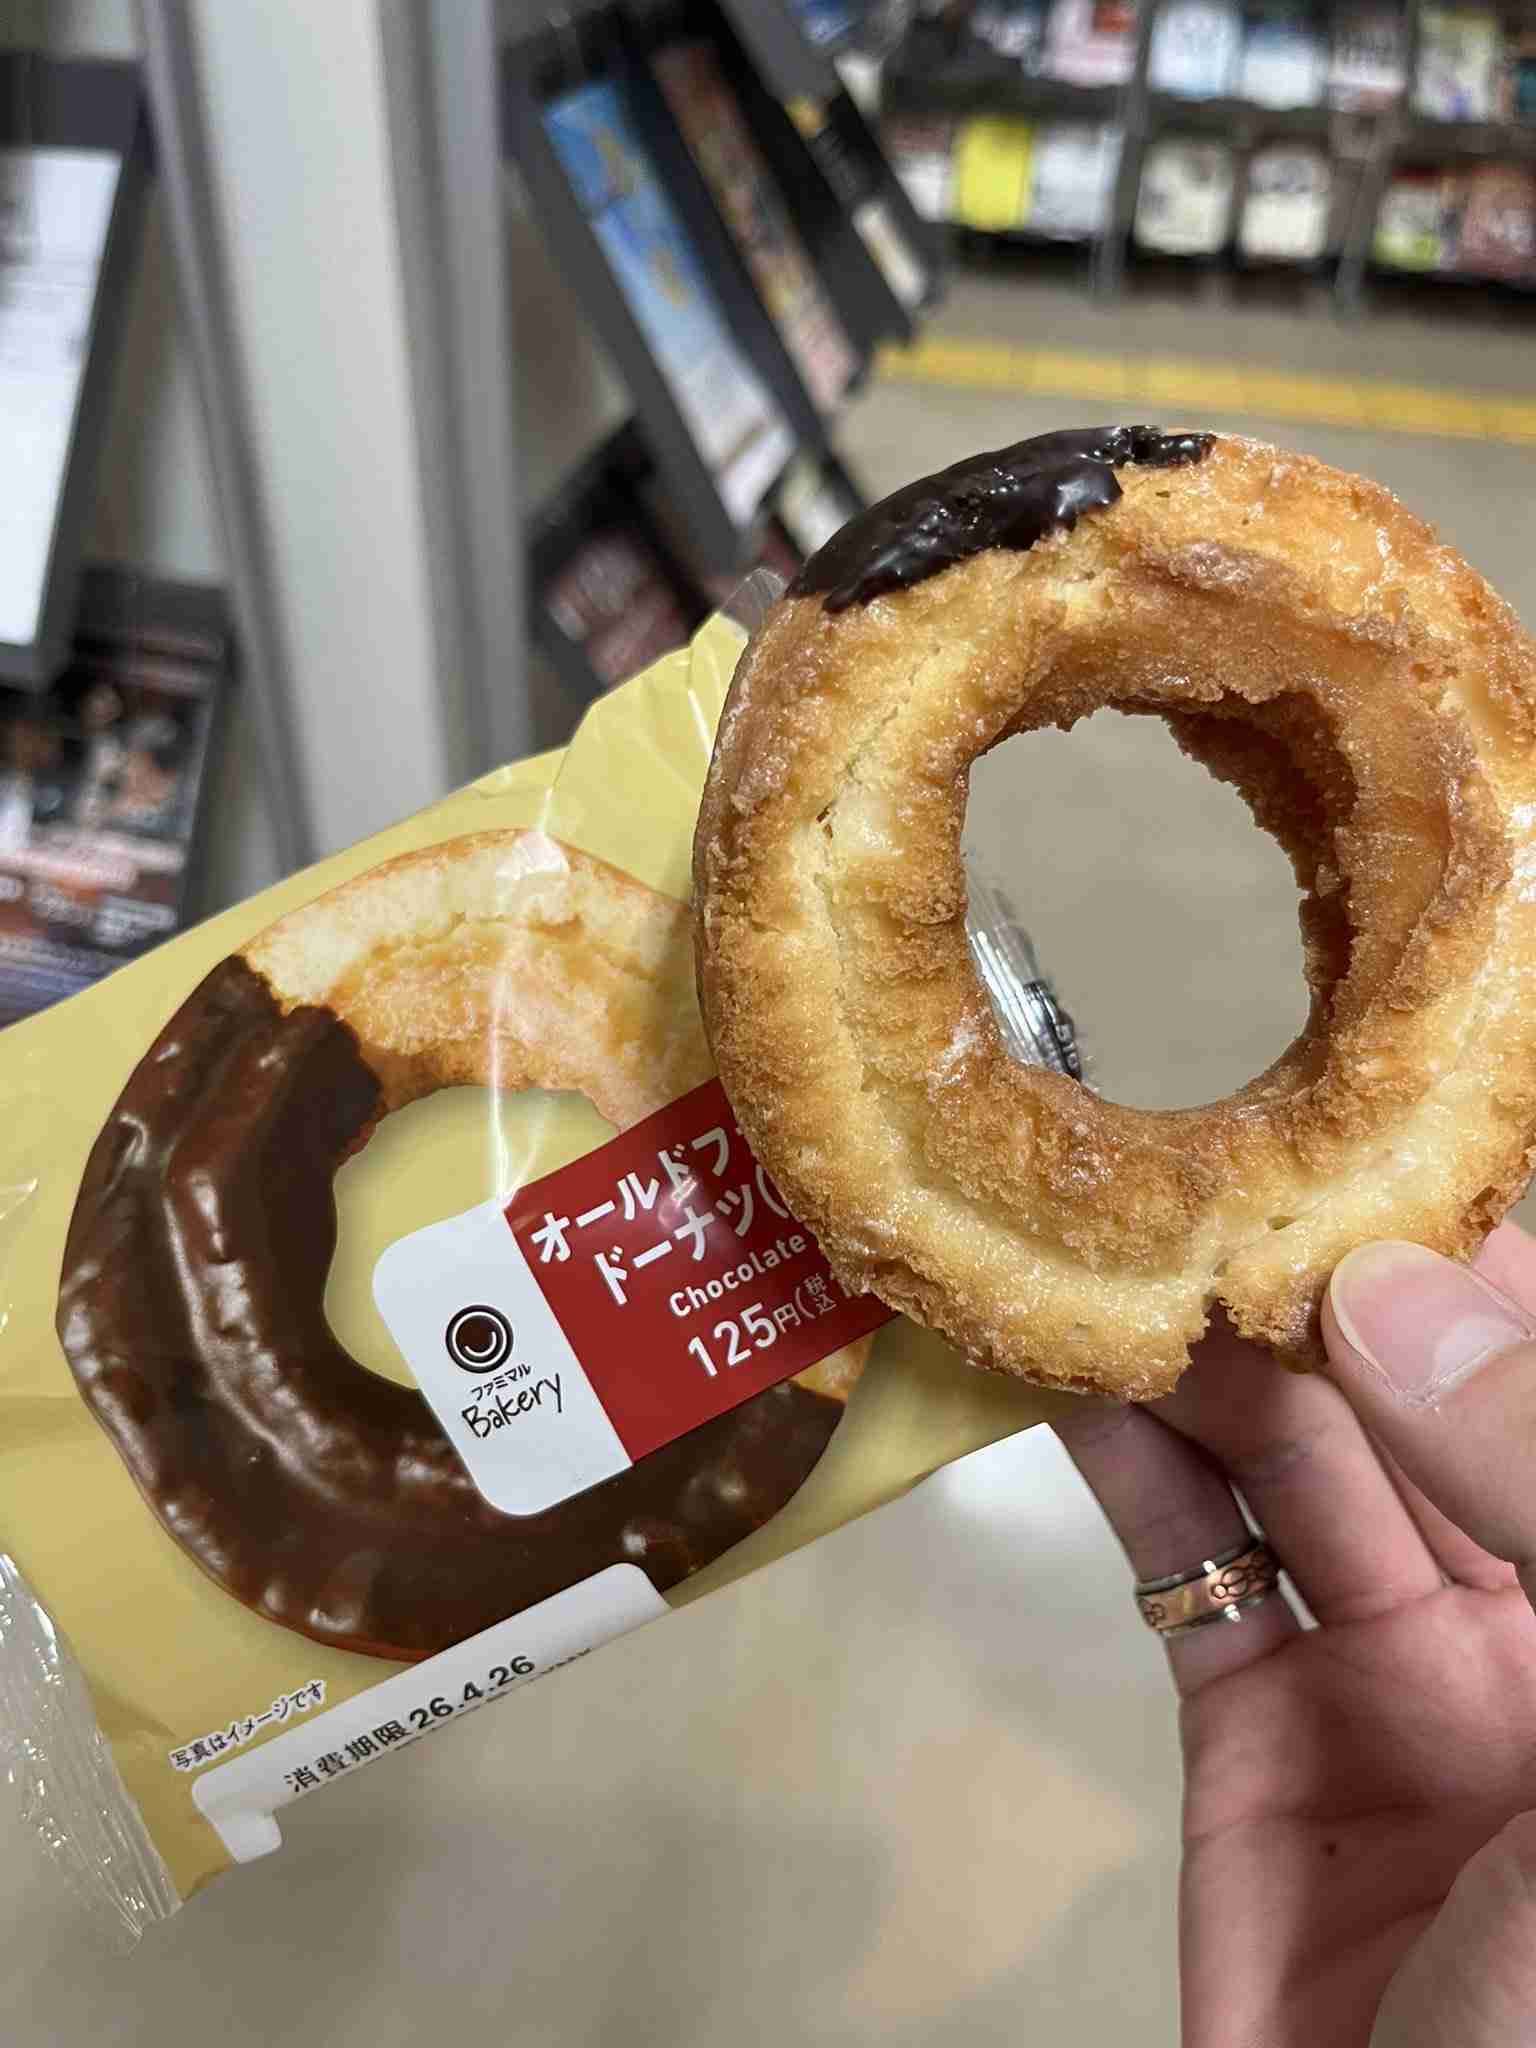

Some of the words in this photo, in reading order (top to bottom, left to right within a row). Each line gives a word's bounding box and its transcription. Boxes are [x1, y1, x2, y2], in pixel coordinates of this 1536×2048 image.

[531, 1128, 741, 1263] オールドフ
[669, 1234, 807, 1318] Chocolate
[461, 1372, 562, 1438] Bakery
[470, 1363, 531, 1401] ファミマル
[171, 1682, 323, 1769] 写真はイメージです
